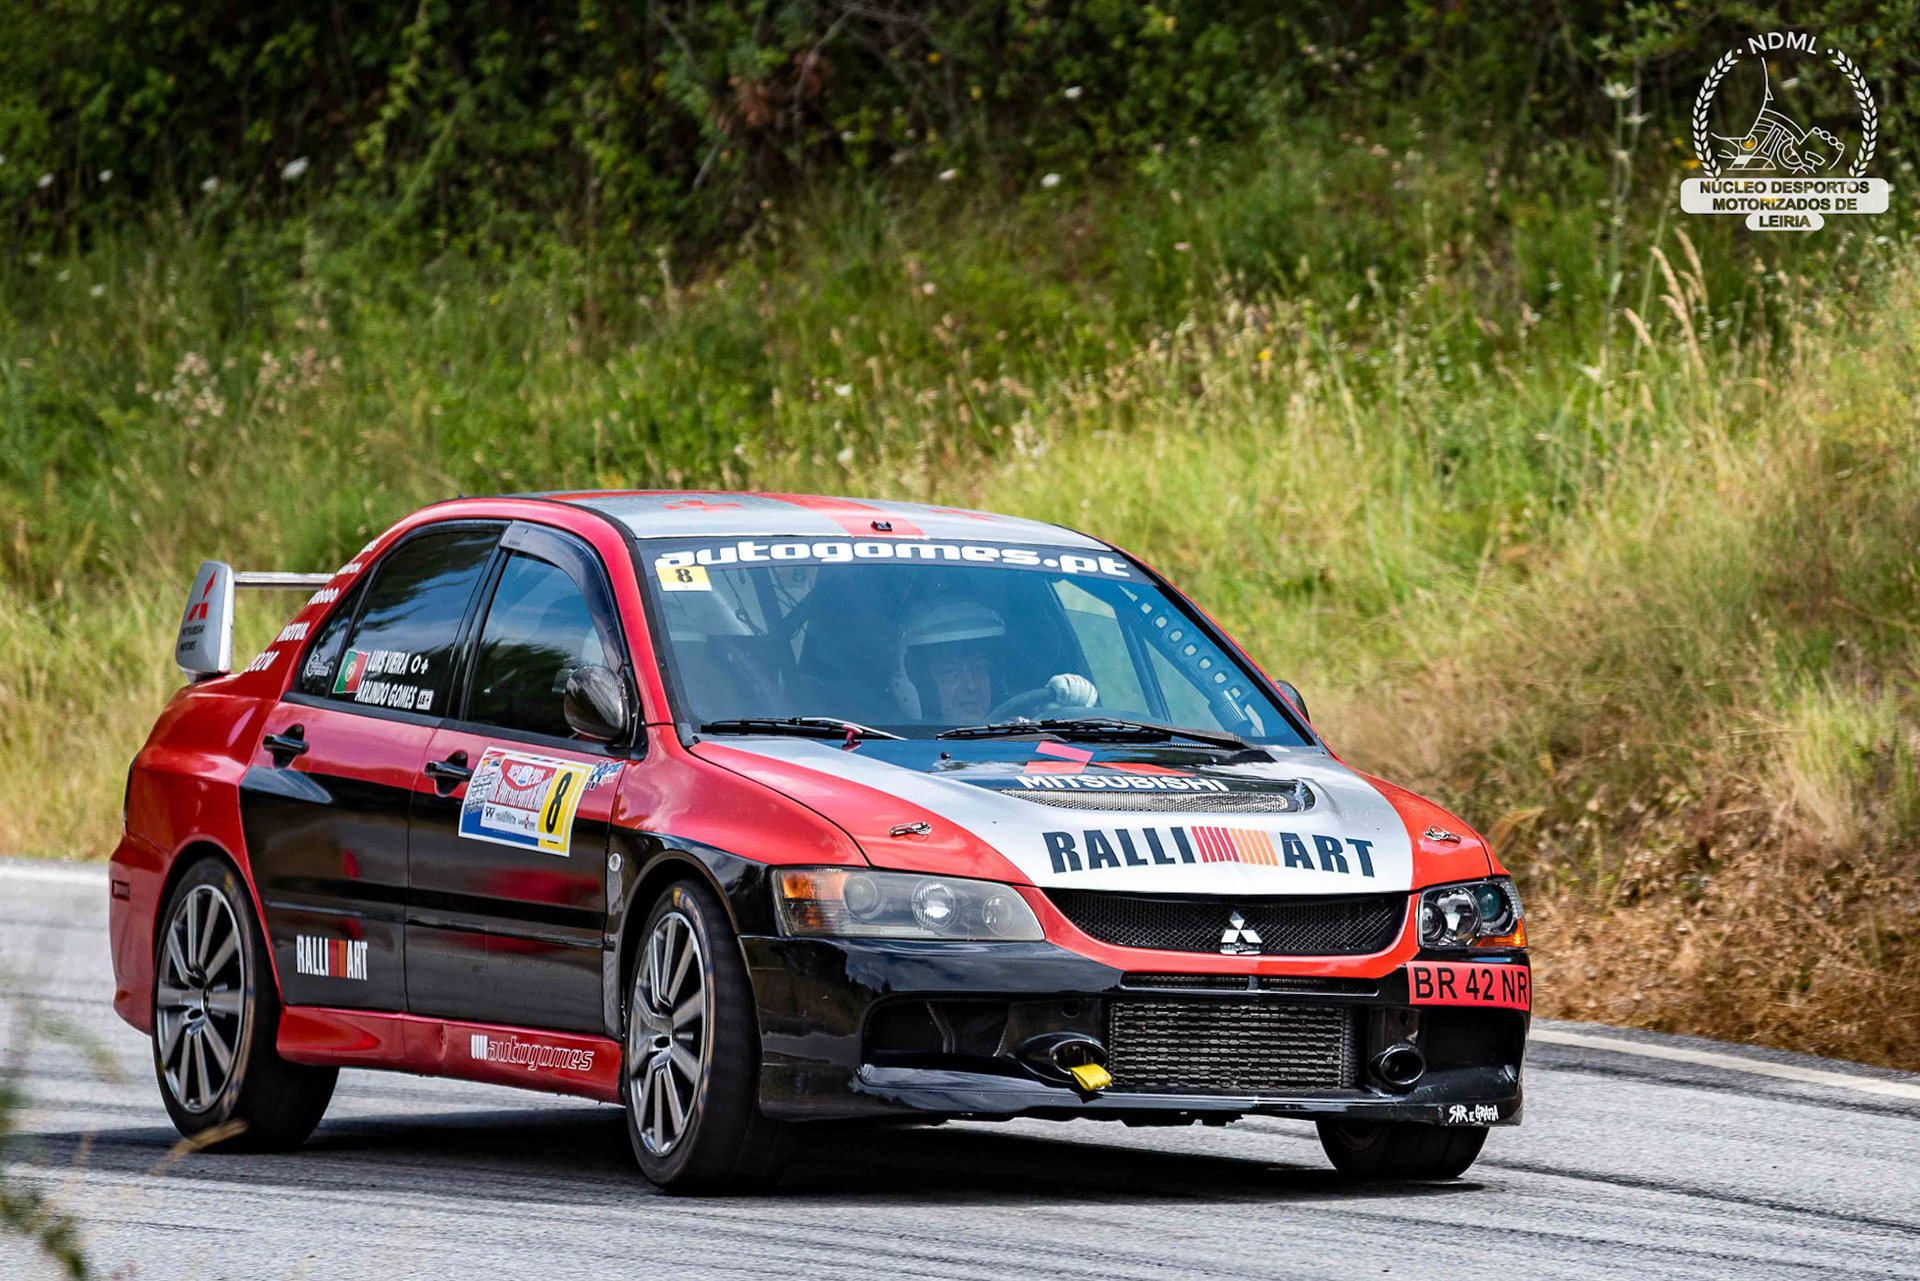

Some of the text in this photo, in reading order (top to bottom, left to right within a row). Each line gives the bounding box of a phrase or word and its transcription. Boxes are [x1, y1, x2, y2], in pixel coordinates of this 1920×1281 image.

[654, 541, 1131, 577] autogomes.pt
[675, 568, 693, 583] 8
[354, 680, 391, 706] ARLINDO
[386, 683, 418, 710] GOMES
[1015, 775, 1229, 792] MITSUBISHI
[545, 771, 573, 834] 8
[1042, 826, 1375, 878] RALLI ART
[296, 935, 368, 981] RALLI ART
[1413, 967, 1529, 1005] BR 42 NR
[487, 1036, 595, 1071] autogomes
